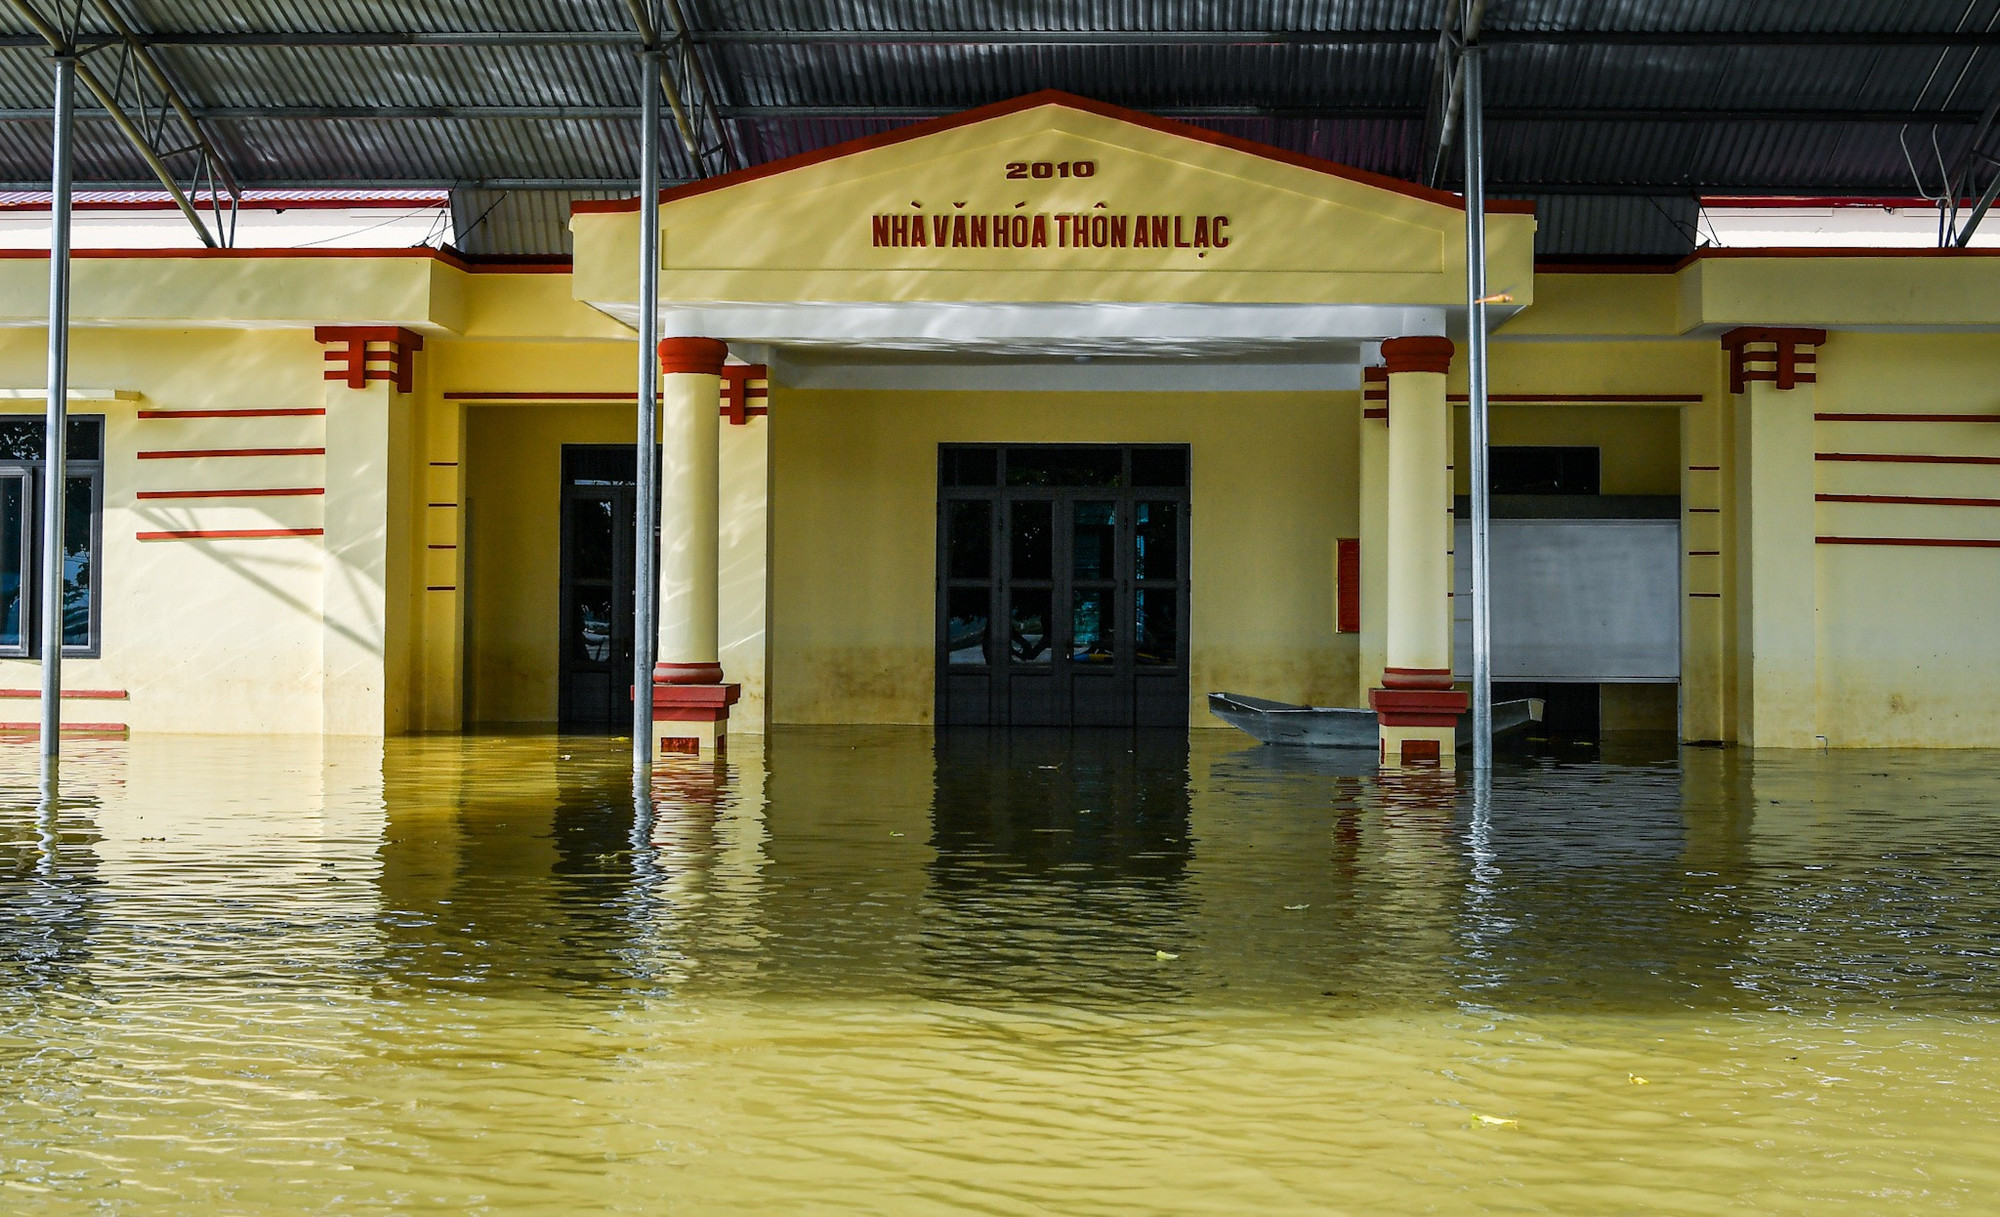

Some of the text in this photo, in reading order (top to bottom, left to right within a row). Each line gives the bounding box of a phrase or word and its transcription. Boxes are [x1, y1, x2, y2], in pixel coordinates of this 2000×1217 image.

[1005, 161, 1096, 179] 2010
[872, 201, 1231, 258] NHÀ VĂN HÓA THÔN AN LẠC
